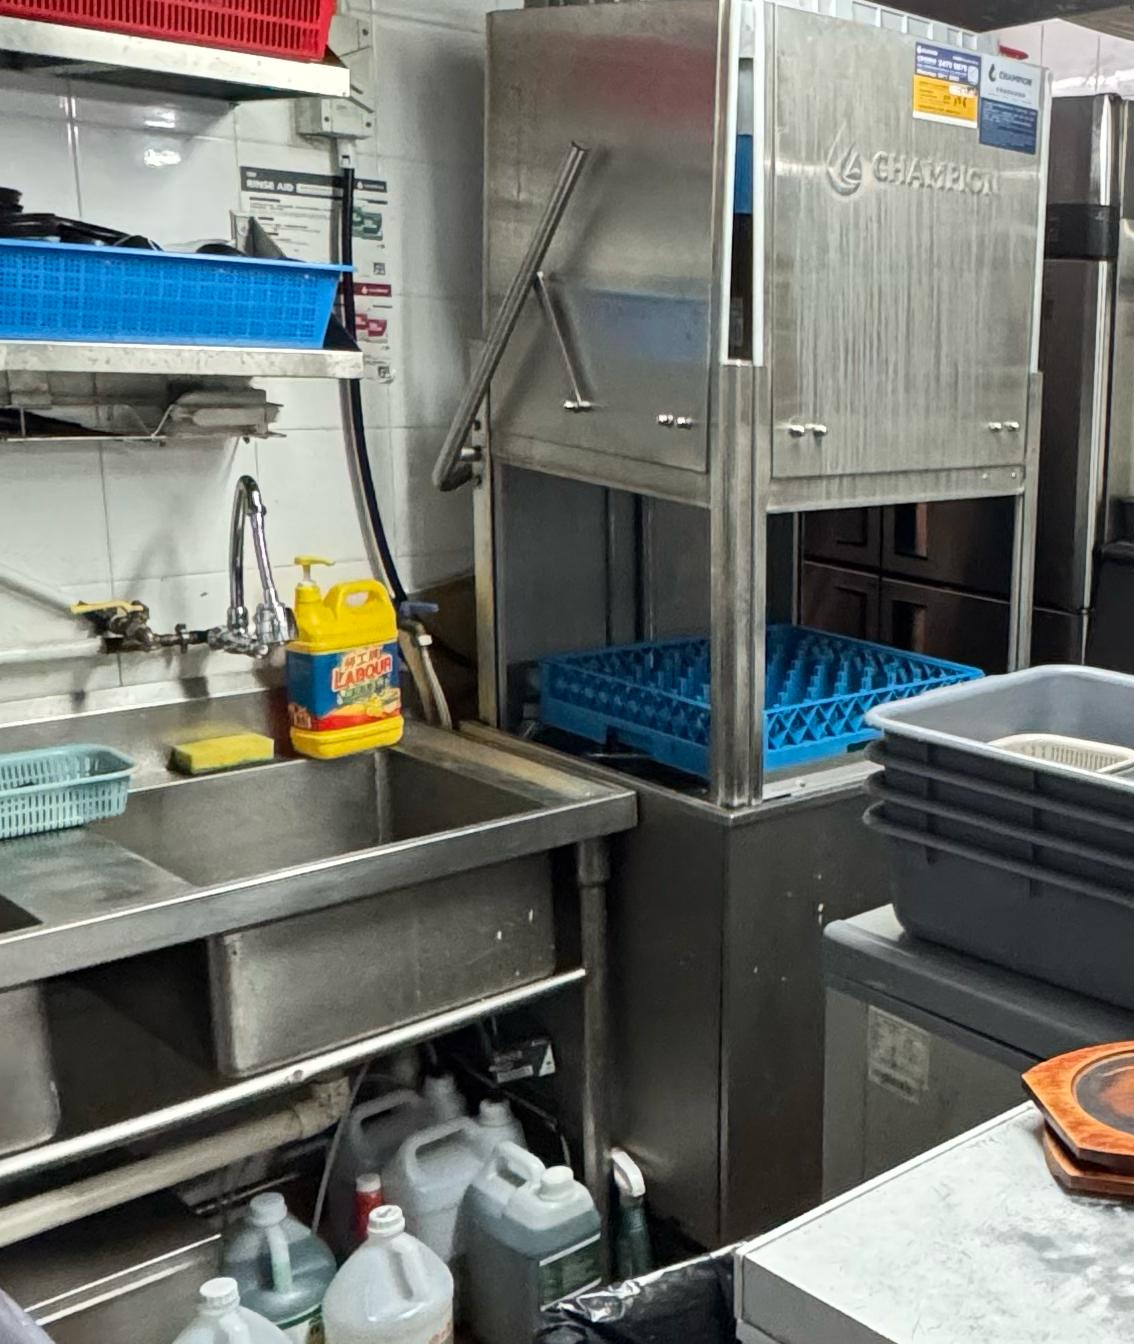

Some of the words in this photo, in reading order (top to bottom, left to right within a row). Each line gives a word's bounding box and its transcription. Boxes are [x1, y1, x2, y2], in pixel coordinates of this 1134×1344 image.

[276, 181, 294, 192] AID
[871, 150, 1000, 197] CHAMPION
[333, 655, 391, 692] LABOUR
